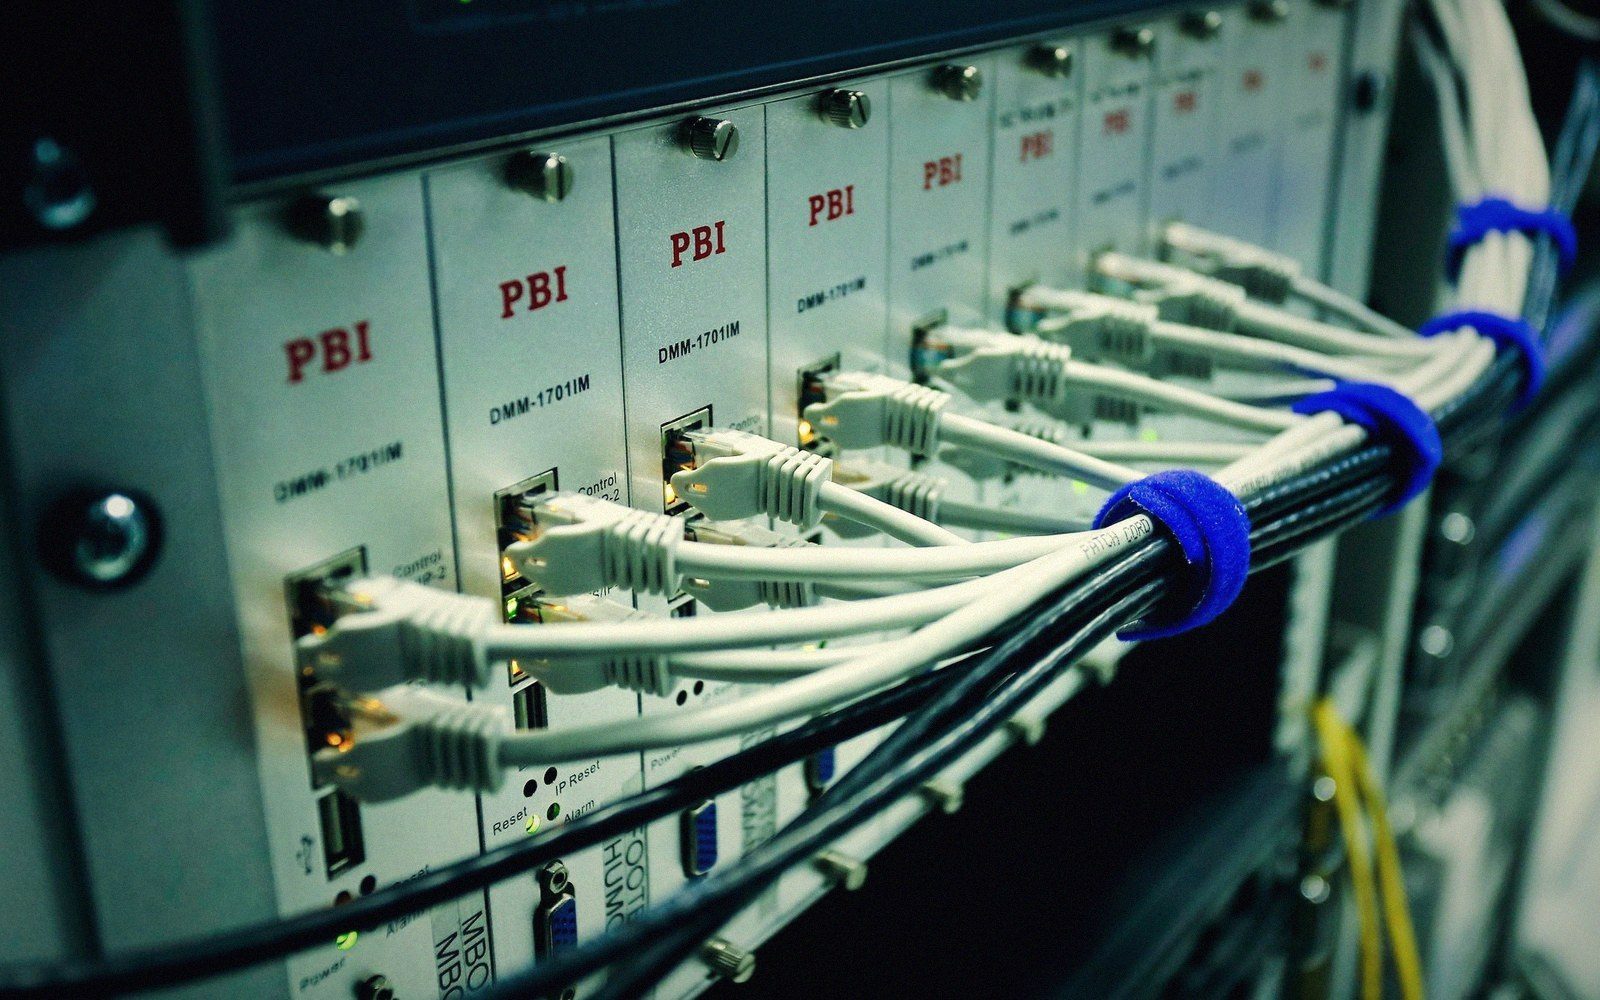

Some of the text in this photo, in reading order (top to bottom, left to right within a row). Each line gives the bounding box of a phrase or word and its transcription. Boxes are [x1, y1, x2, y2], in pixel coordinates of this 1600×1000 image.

[923, 153, 962, 190] PBI
[808, 185, 856, 227] PBI
[669, 221, 726, 268] PBI
[499, 265, 569, 319] PBI
[284, 320, 373, 384] PBI
[658, 321, 740, 365] DMM-1701IM
[489, 374, 591, 425] DMM-1701IM
[1081, 518, 1151, 560] PATCH CORD
[555, 760, 601, 797] IP Reset
[492, 806, 528, 836] Reset
[563, 799, 596, 826] Alarm
[461, 910, 490, 992] MBO
